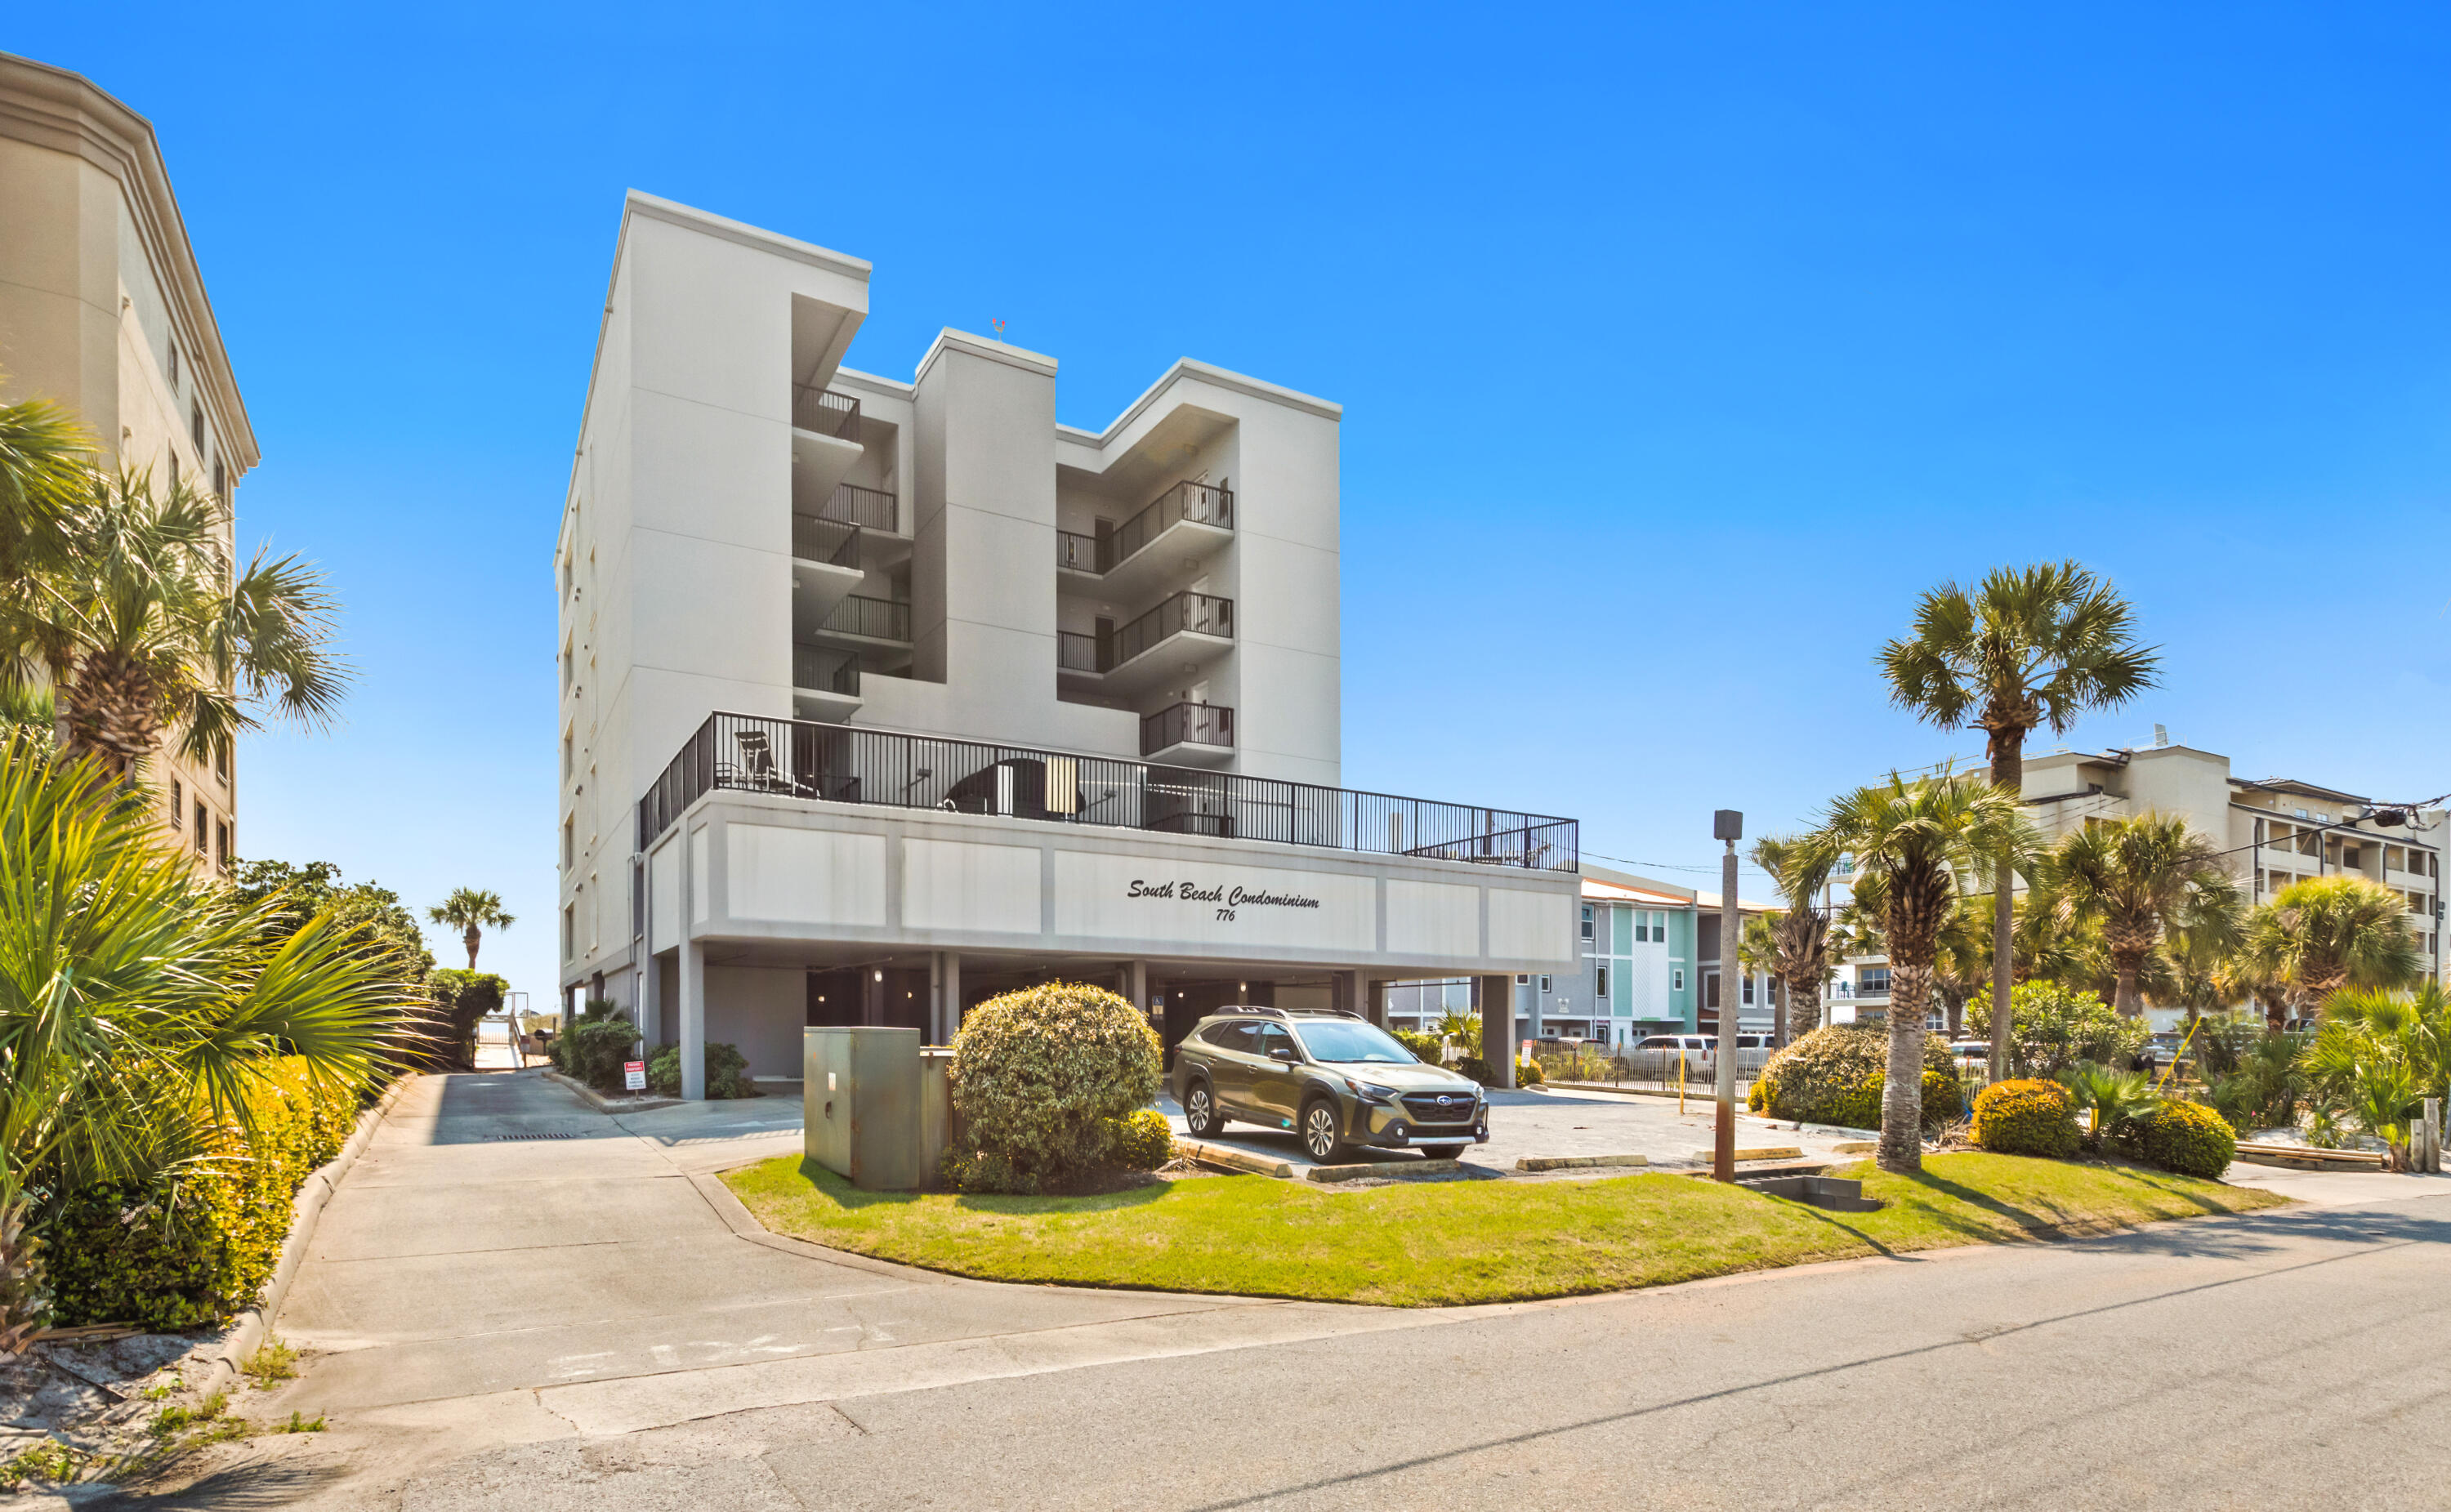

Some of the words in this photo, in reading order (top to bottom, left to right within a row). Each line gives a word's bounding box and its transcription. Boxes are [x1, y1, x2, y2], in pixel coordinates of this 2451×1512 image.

[1127, 880, 1174, 899] South
[1180, 882, 1223, 902] Beach
[1228, 885, 1319, 909] Condominium
[1216, 908, 1236, 922] 776
